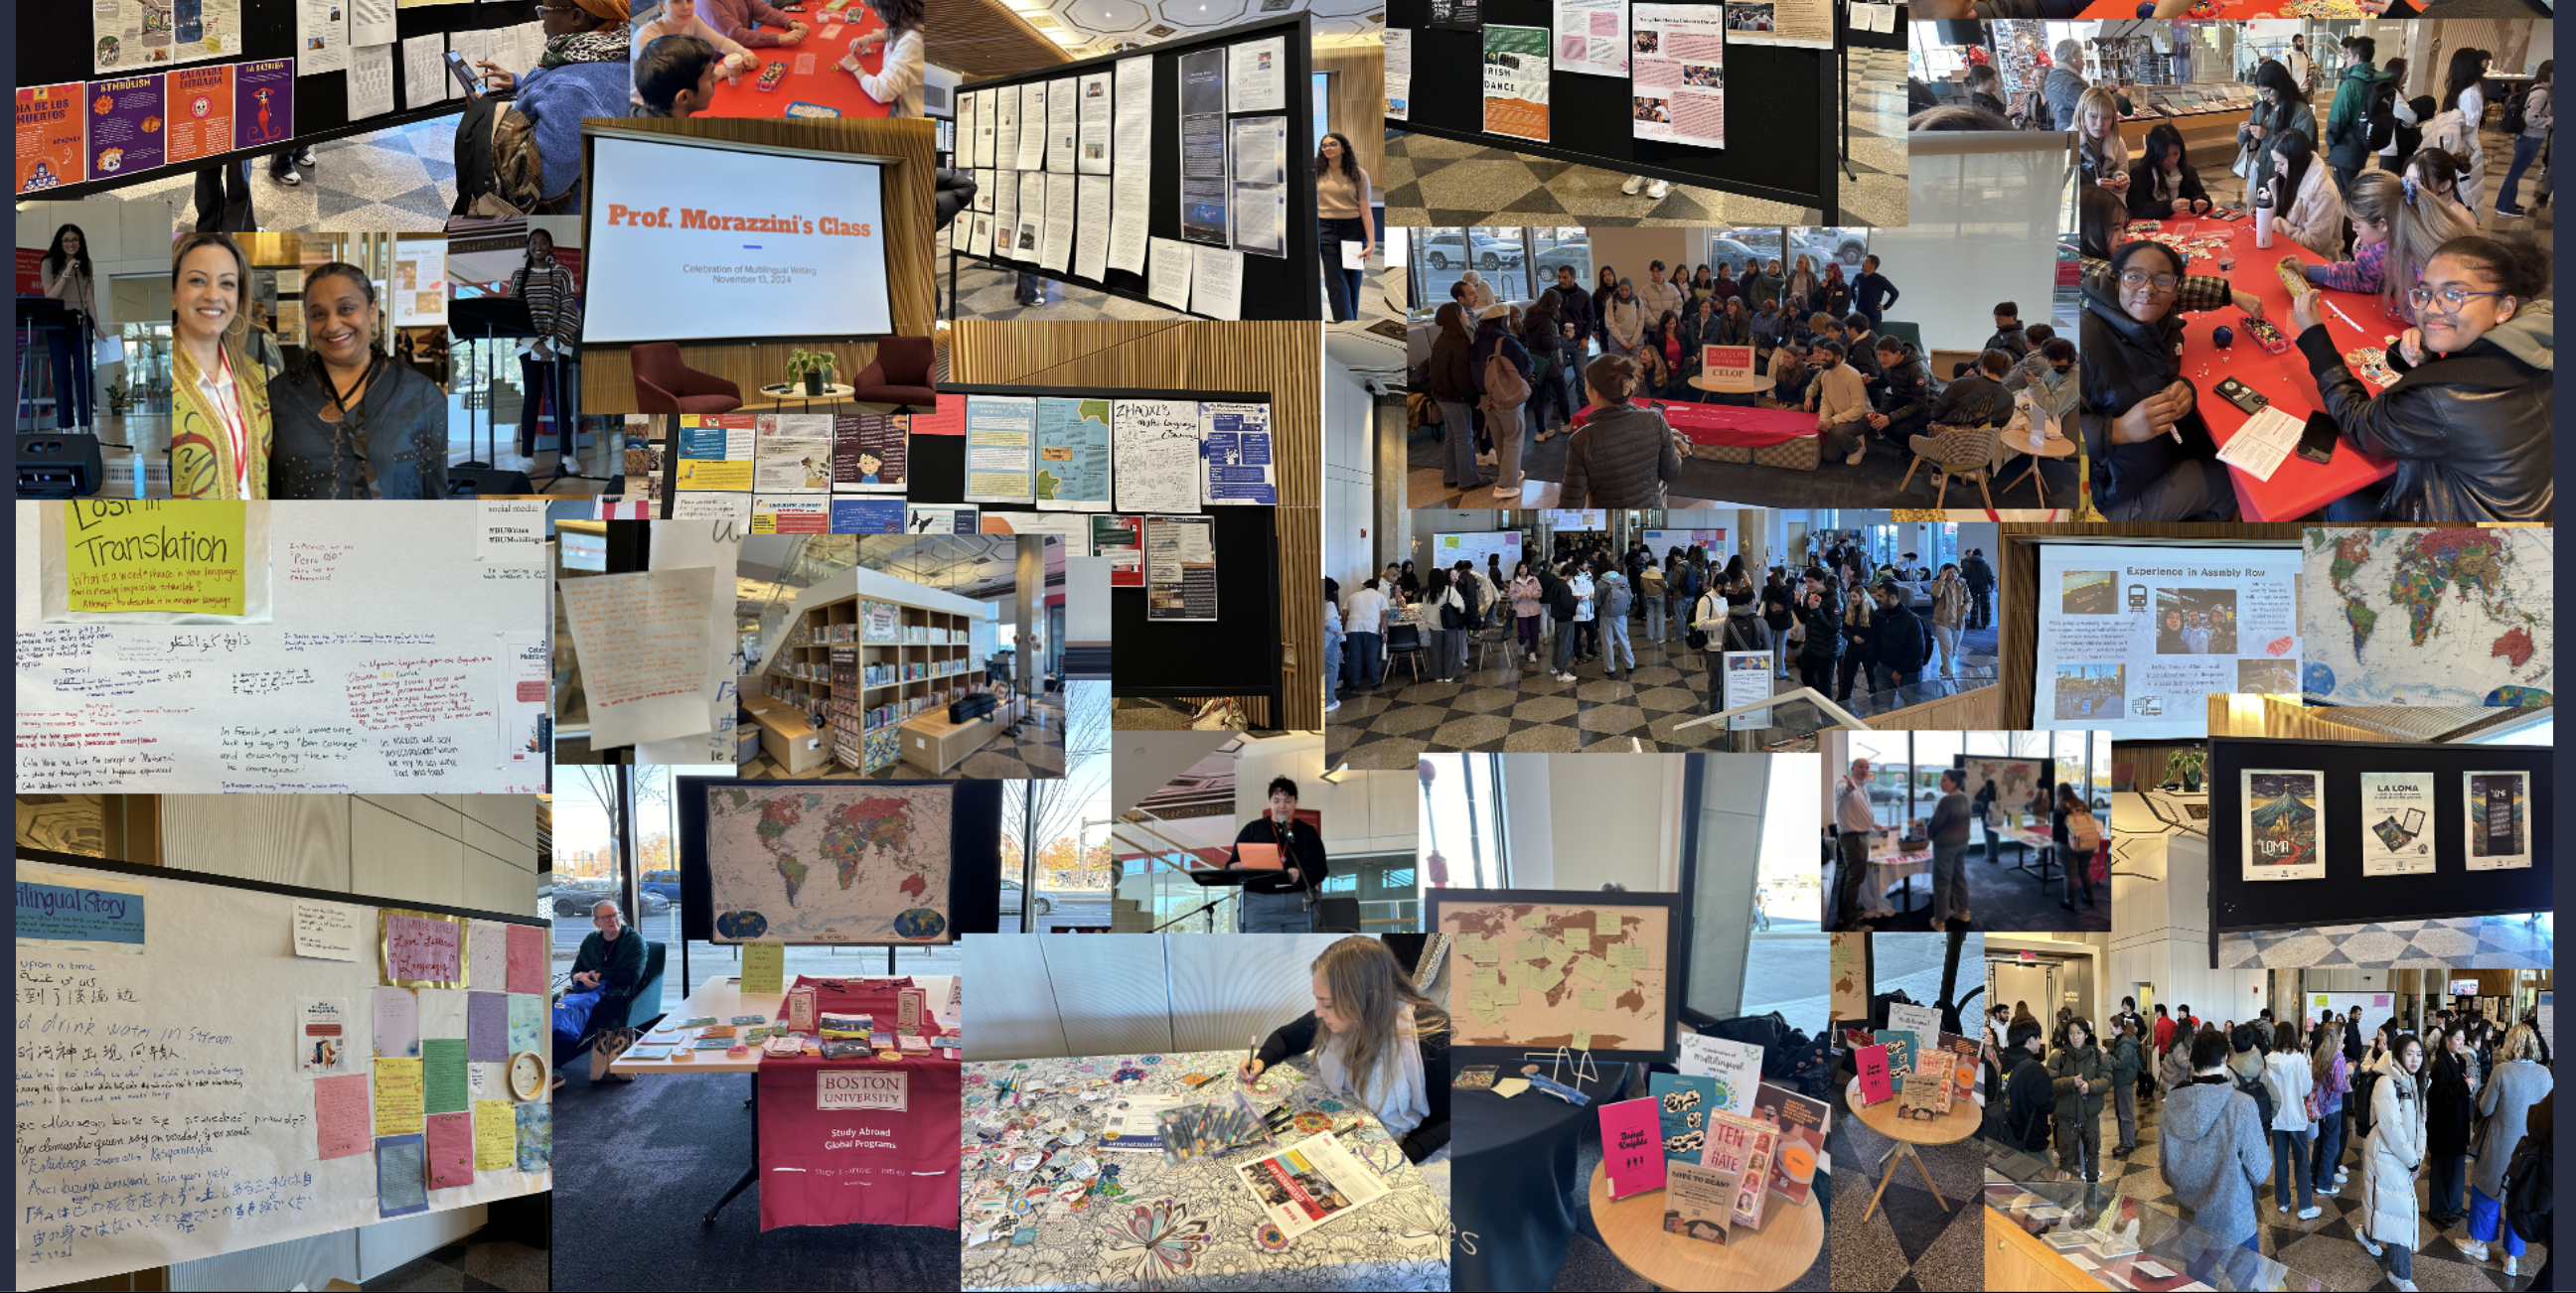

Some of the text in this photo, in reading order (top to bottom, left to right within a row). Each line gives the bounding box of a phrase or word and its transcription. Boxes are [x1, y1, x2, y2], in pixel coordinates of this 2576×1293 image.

[1484, 67, 1511, 77] IRISH
[1484, 80, 1515, 92] DANCE
[608, 204, 871, 237] Prof. Morazzini's Class
[682, 263, 817, 277] Celebration of Multilingual Writing
[713, 275, 792, 285] November 13, 2024
[1712, 369, 1744, 378] CELOP
[75, 525, 227, 567] Translation
[73, 570, 99, 586] What
[102, 573, 109, 582] is
[120, 568, 143, 582] word
[149, 569, 174, 581] phrase
[177, 568, 183, 577] in
[185, 569, 201, 580] your
[205, 567, 238, 582] language
[2126, 567, 2265, 578] Experience in Assmbly Row
[127, 596, 155, 605] describe
[174, 596, 200, 605] another
[221, 726, 229, 735] In
[244, 738, 254, 749] by
[259, 739, 289, 749] saying
[220, 751, 238, 760] and
[304, 751, 329, 759] them
[84, 891, 125, 919] Story
[394, 934, 419, 948] Love
[20, 960, 51, 971] upon
[57, 961, 65, 970] a
[42, 1012, 182, 1040] drink water in
[1702, 1047, 1730, 1057] Celebration
[1694, 1053, 1745, 1071] Multilingual
[825, 1076, 900, 1090] BOSTON
[61, 1095, 71, 1104] be
[825, 1093, 900, 1104] UNIVERSITY
[832, 1127, 891, 1138] Study Abroad
[1718, 1124, 1744, 1148] TEN
[825, 1140, 897, 1150] Global Programs
[1711, 1150, 1739, 1171] HATE
